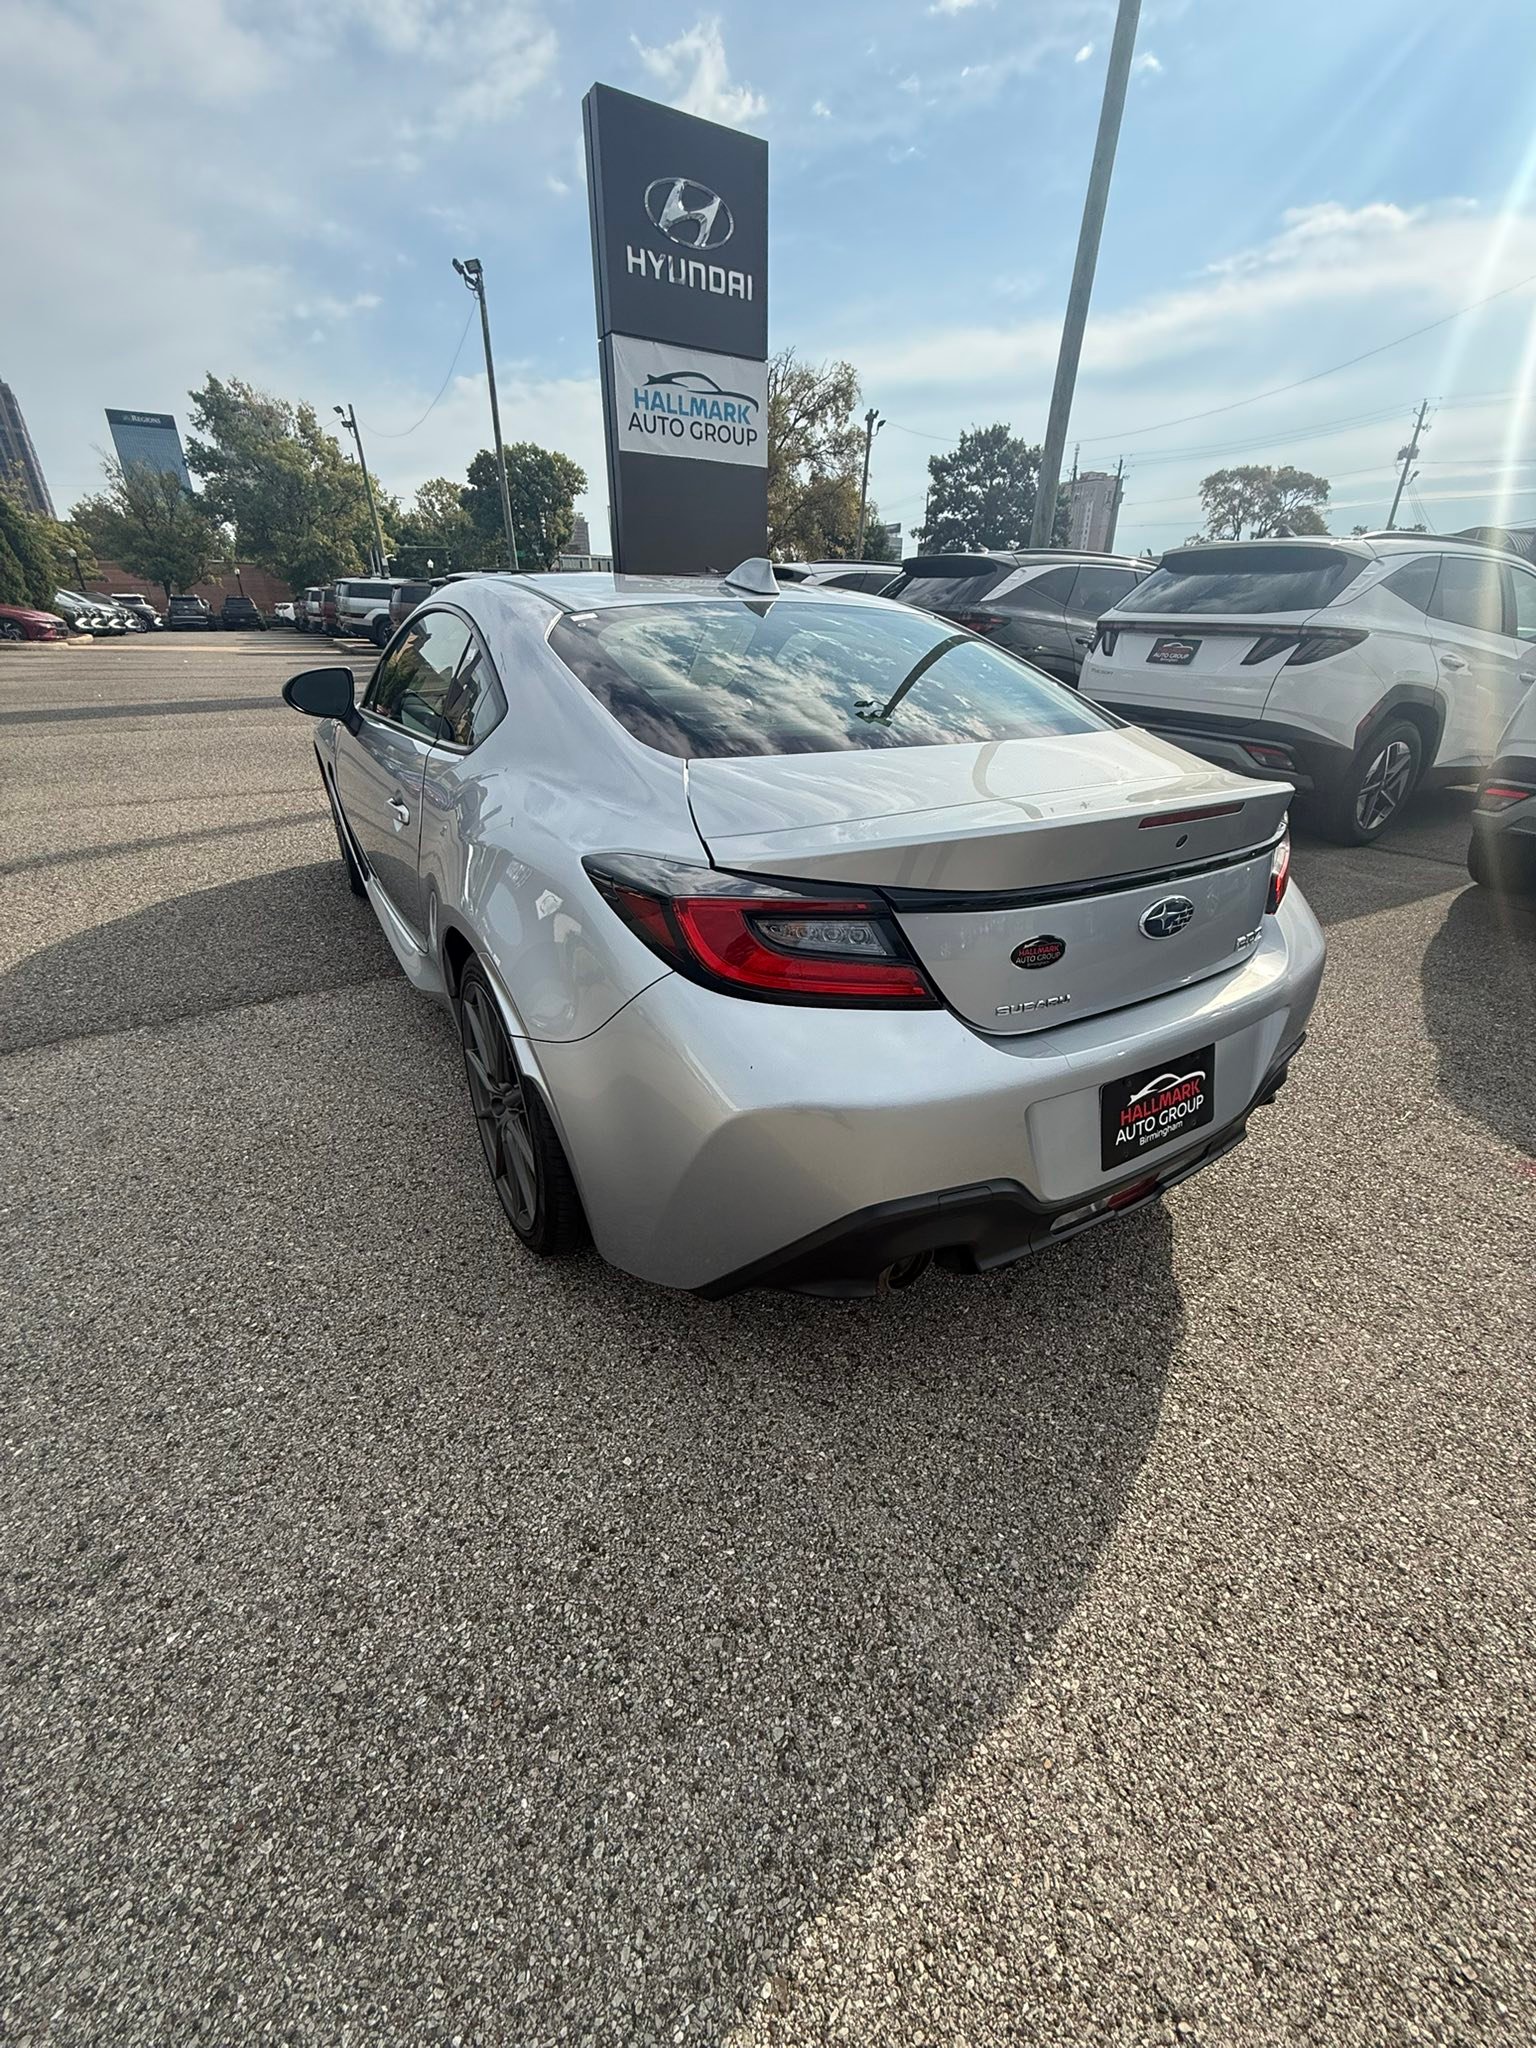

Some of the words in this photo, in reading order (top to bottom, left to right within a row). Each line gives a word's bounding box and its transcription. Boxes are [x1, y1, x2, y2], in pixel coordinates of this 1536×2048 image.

[626, 244, 753, 301] HYUNDAI
[131, 414, 161, 424] REGIONS
[633, 387, 752, 425] HALLMARK
[628, 412, 685, 439] AUTO
[689, 420, 758, 447] GROUP
[1015, 955, 1036, 964] AUTO
[1037, 951, 1061, 962] GROUP
[1018, 944, 1060, 962] HALLMARK
[995, 993, 1071, 1017] SUBARU
[1120, 1077, 1201, 1127] HALLMARK
[1115, 1116, 1156, 1146] AUTO
[1159, 1094, 1204, 1126] GROUP
[1139, 1120, 1183, 1146] Birmingham
